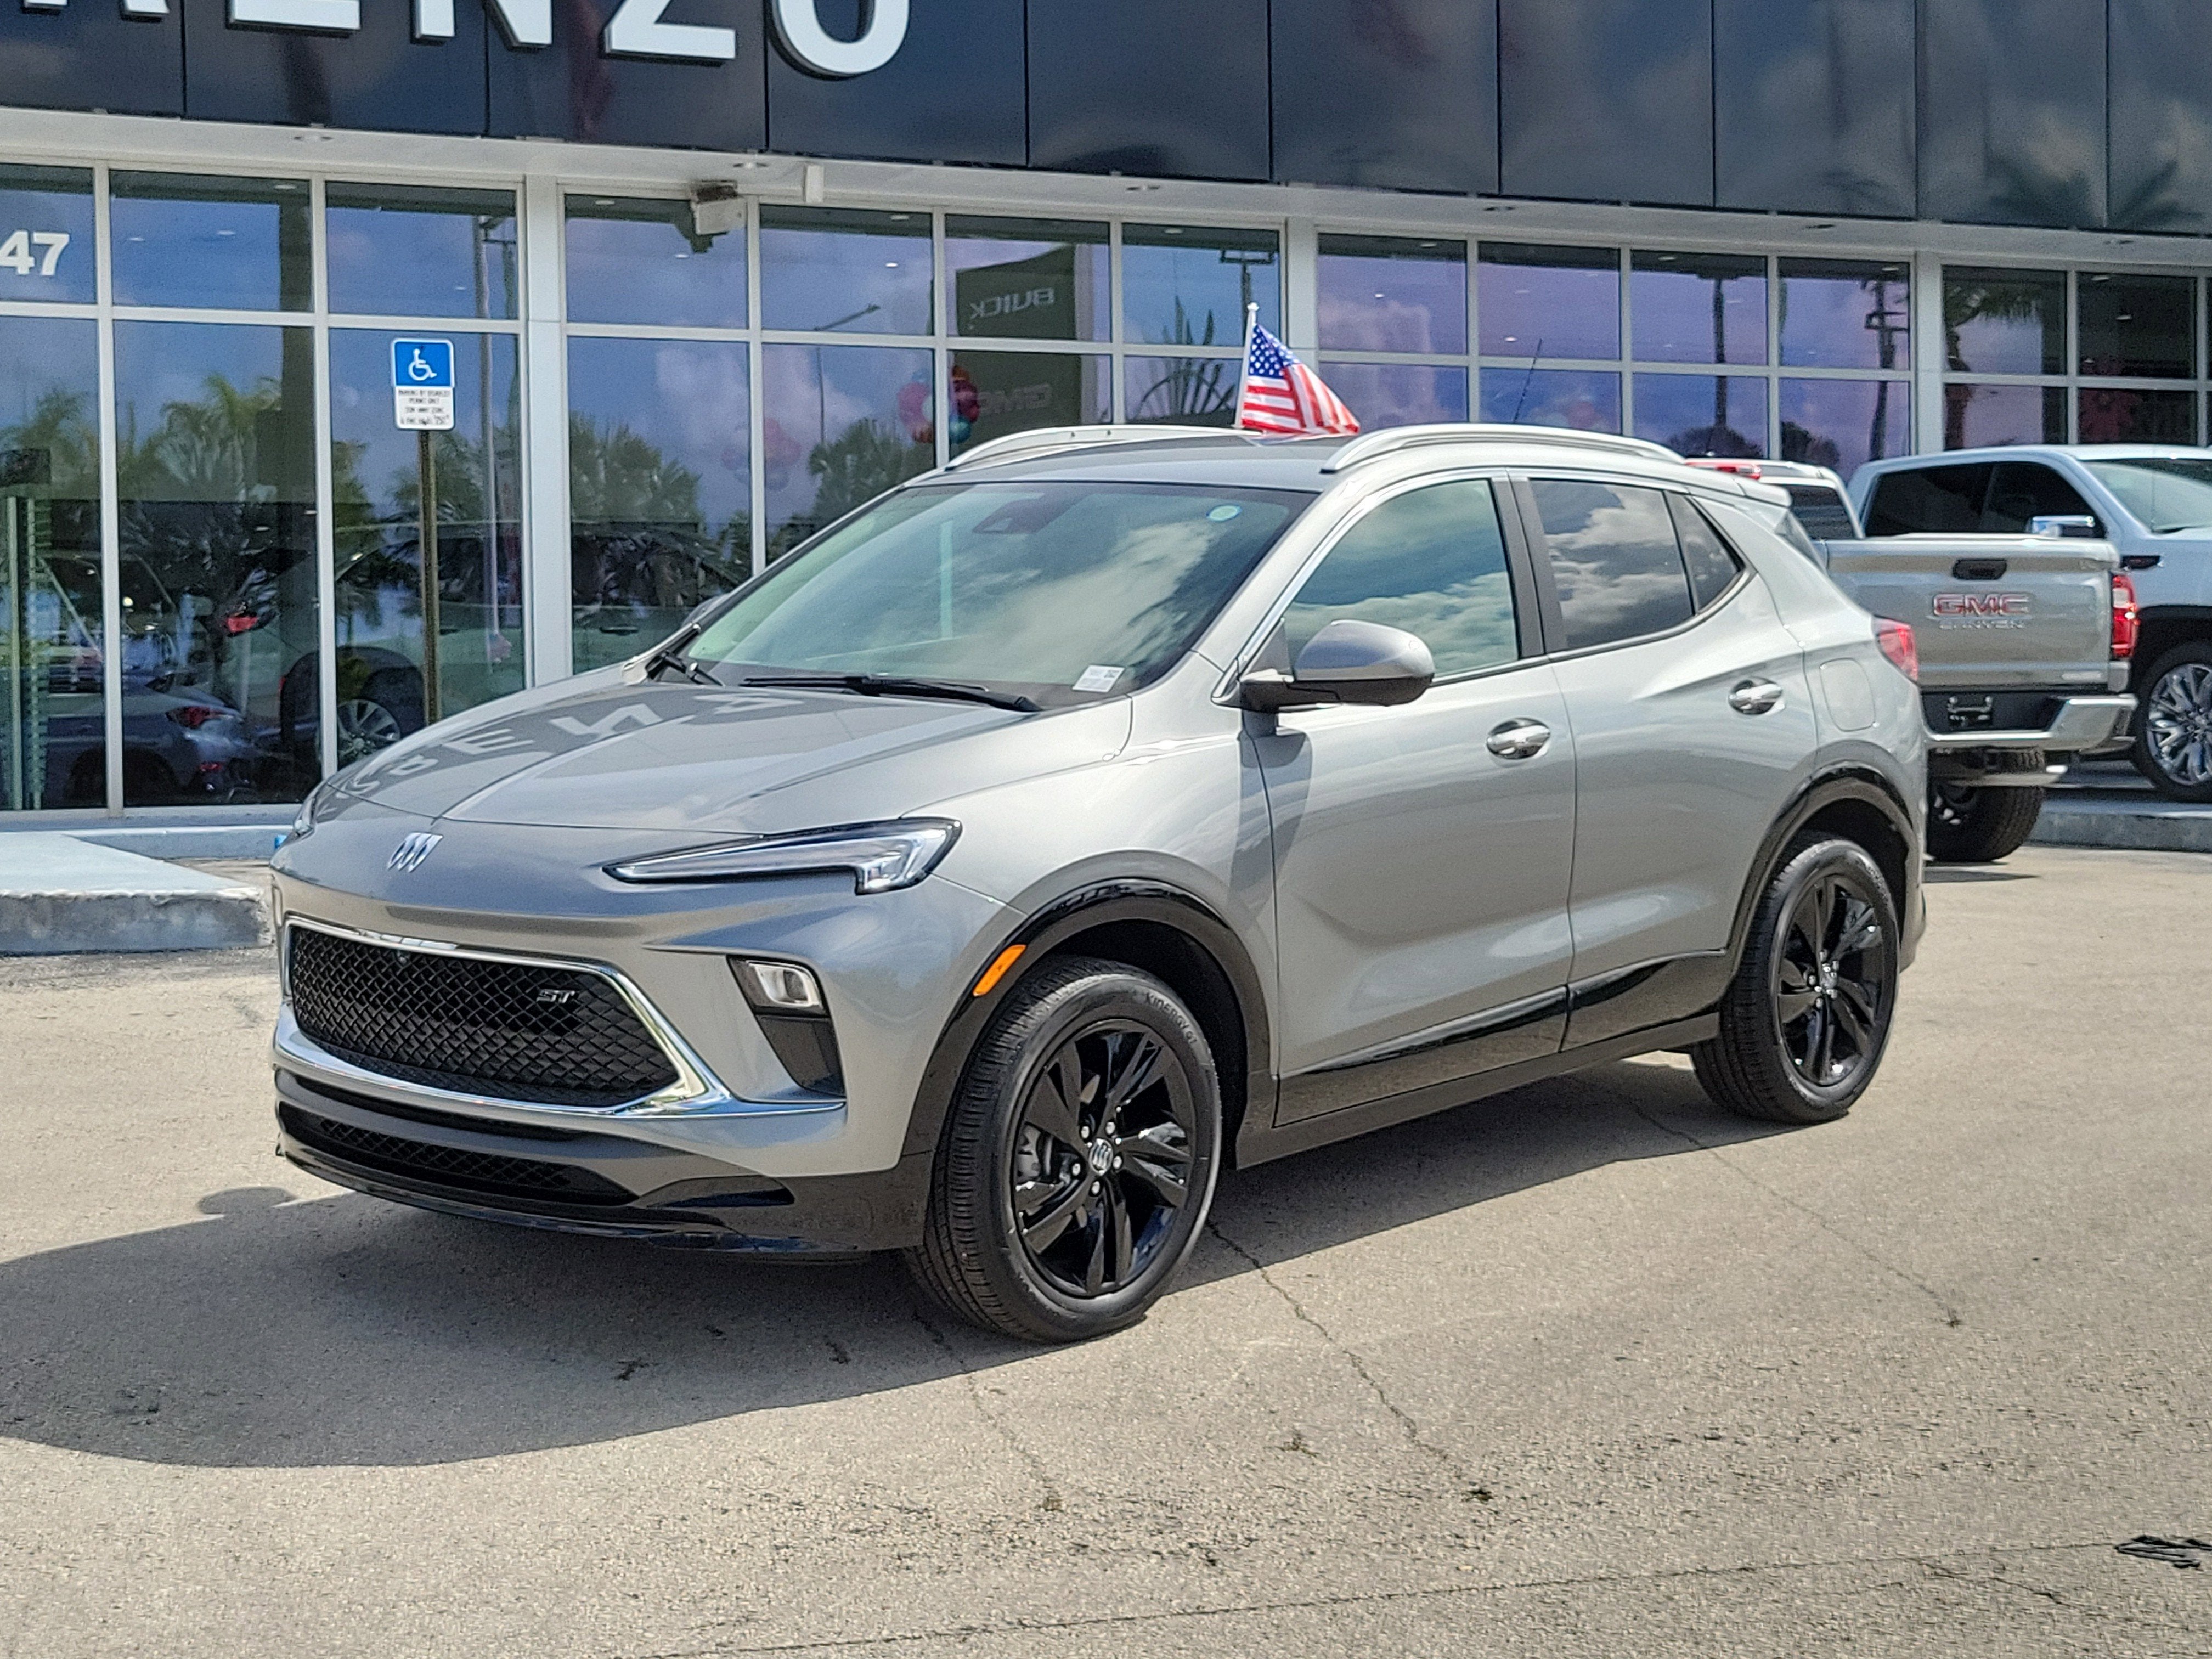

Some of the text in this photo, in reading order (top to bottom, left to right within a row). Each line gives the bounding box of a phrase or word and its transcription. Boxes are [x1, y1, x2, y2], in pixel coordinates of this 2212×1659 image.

[0, 230, 70, 276] 47
[1933, 593, 2029, 616] GMC
[536, 989, 575, 1004] ST
